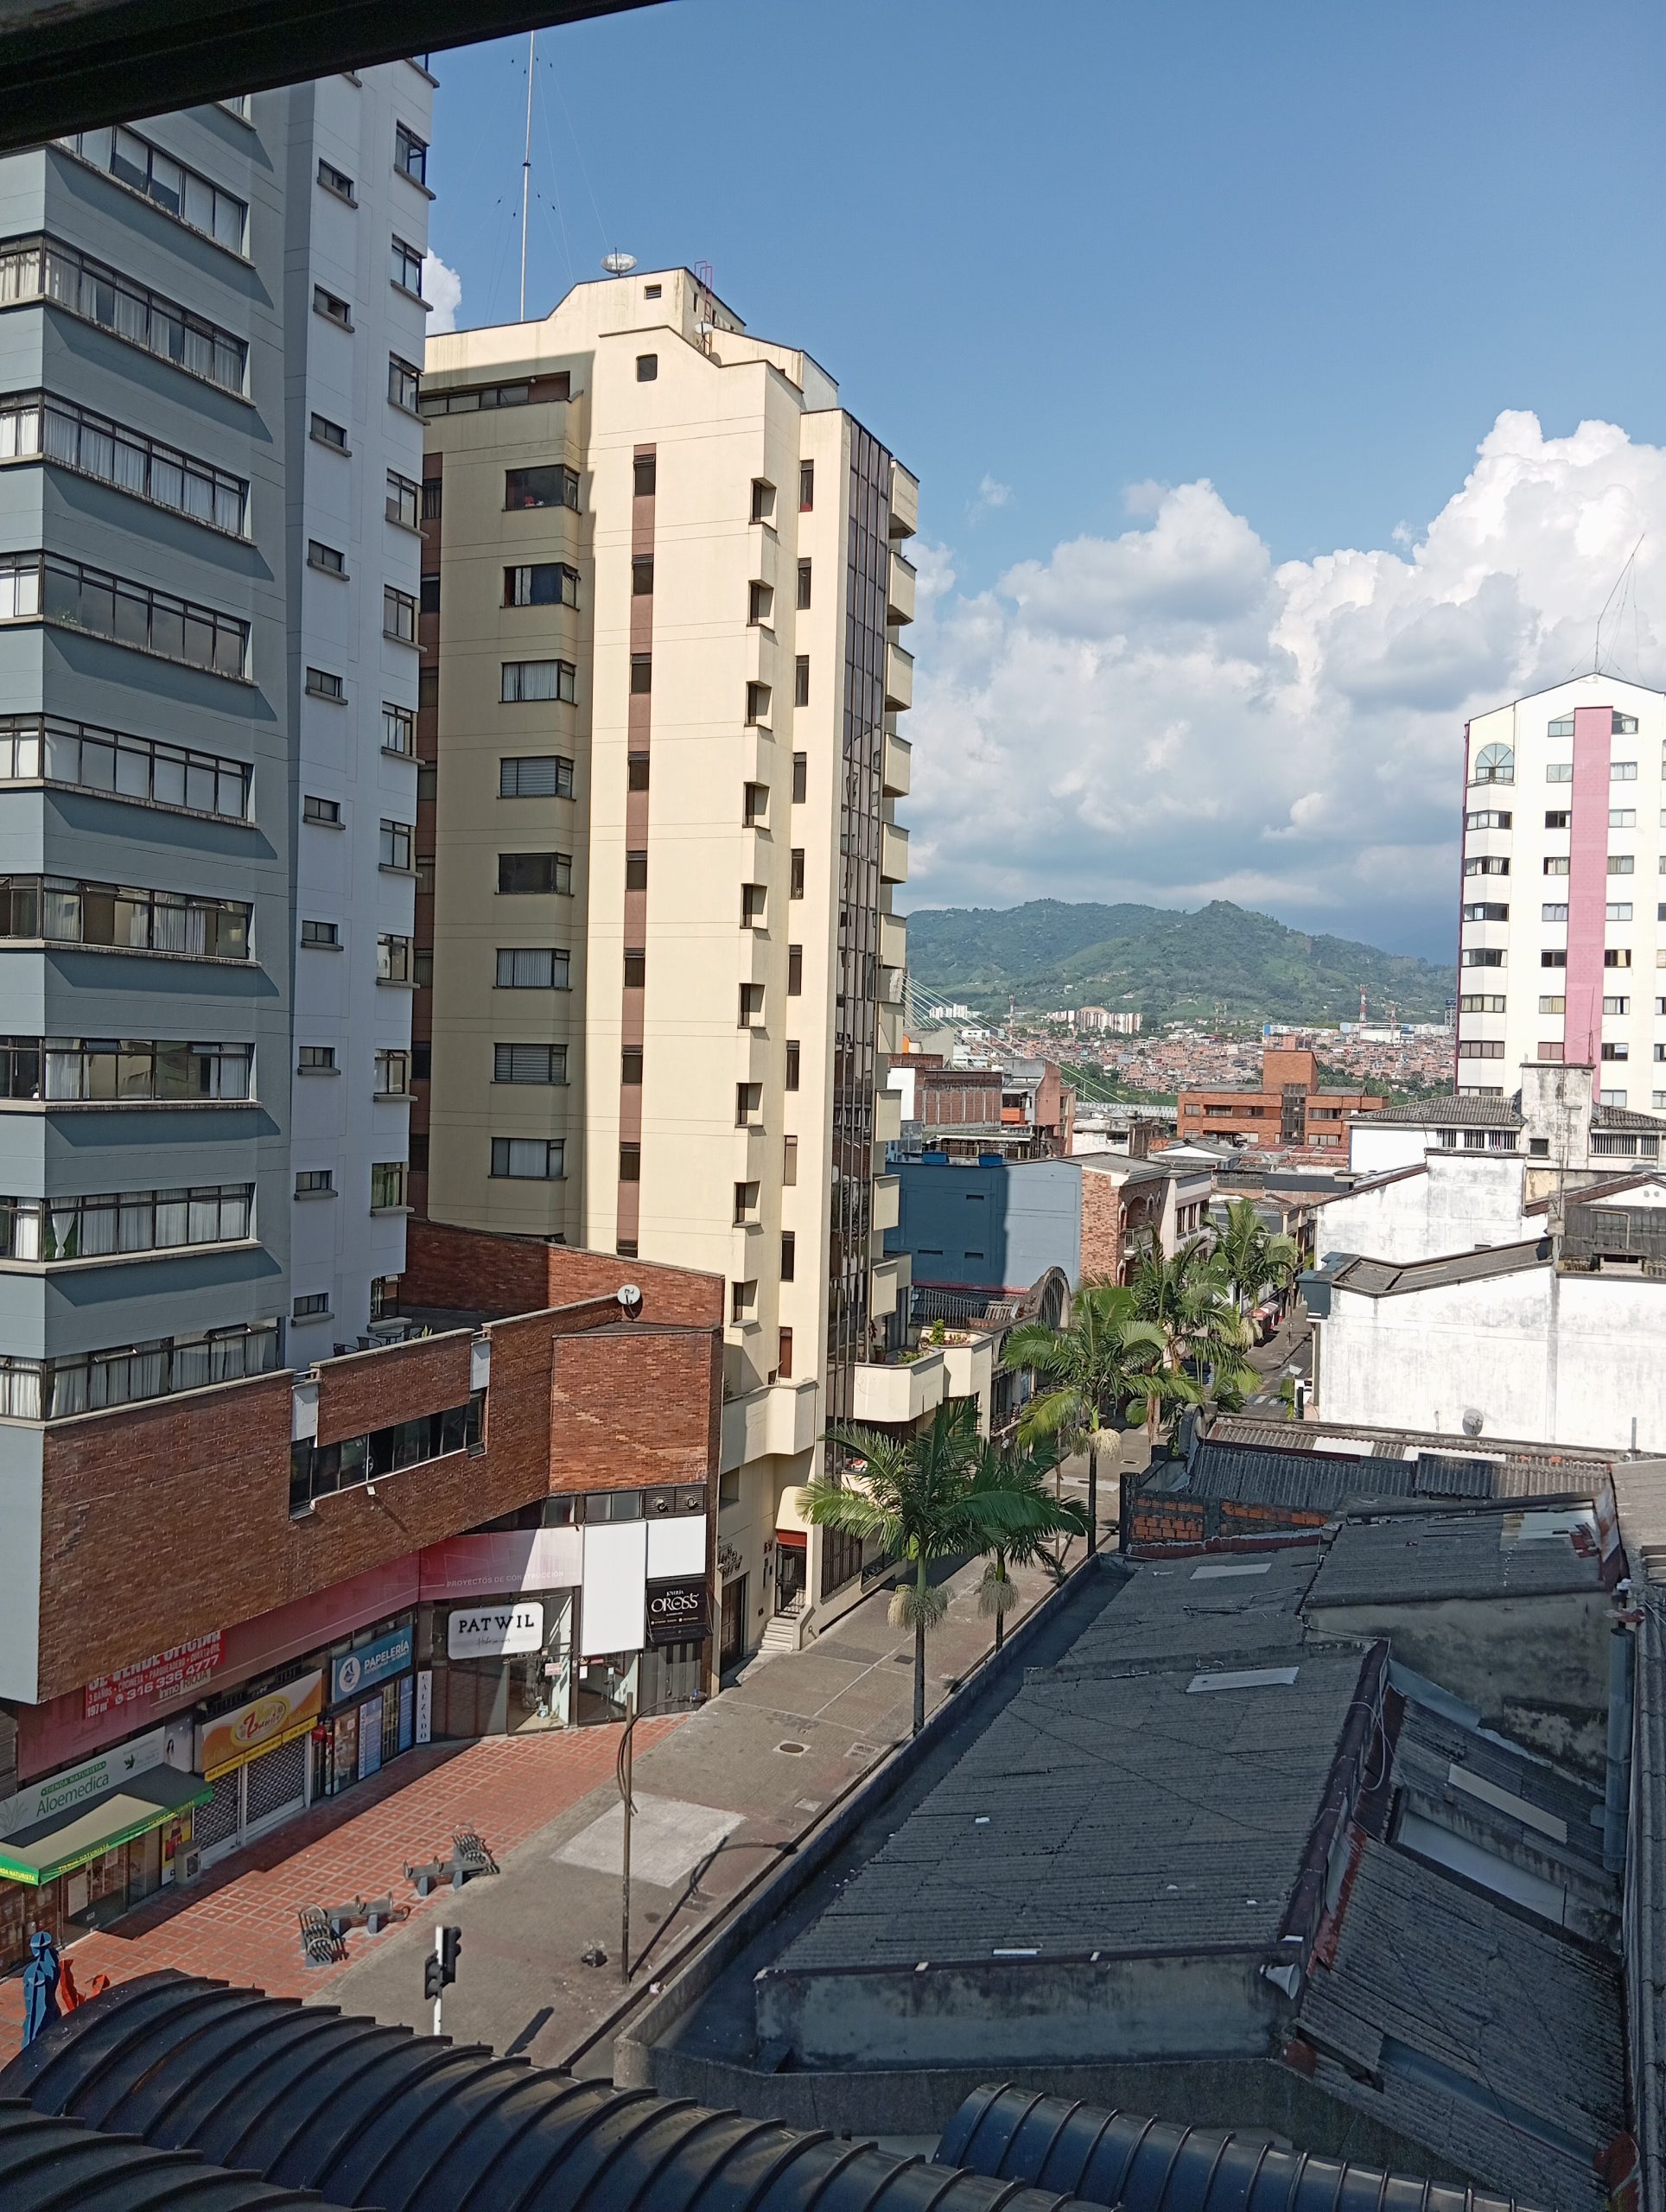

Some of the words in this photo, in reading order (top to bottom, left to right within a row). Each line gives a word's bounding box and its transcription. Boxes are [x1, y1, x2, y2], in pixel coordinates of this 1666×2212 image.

[447, 1577, 493, 1588] PROYECTOS
[458, 1614, 534, 1633] PATWIL
[186, 1654, 219, 1675] 4777
[364, 1639, 410, 1670] PAPELERÍA
[420, 1673, 429, 1739] CALZADO
[36, 1773, 110, 1816] Aloemedica
